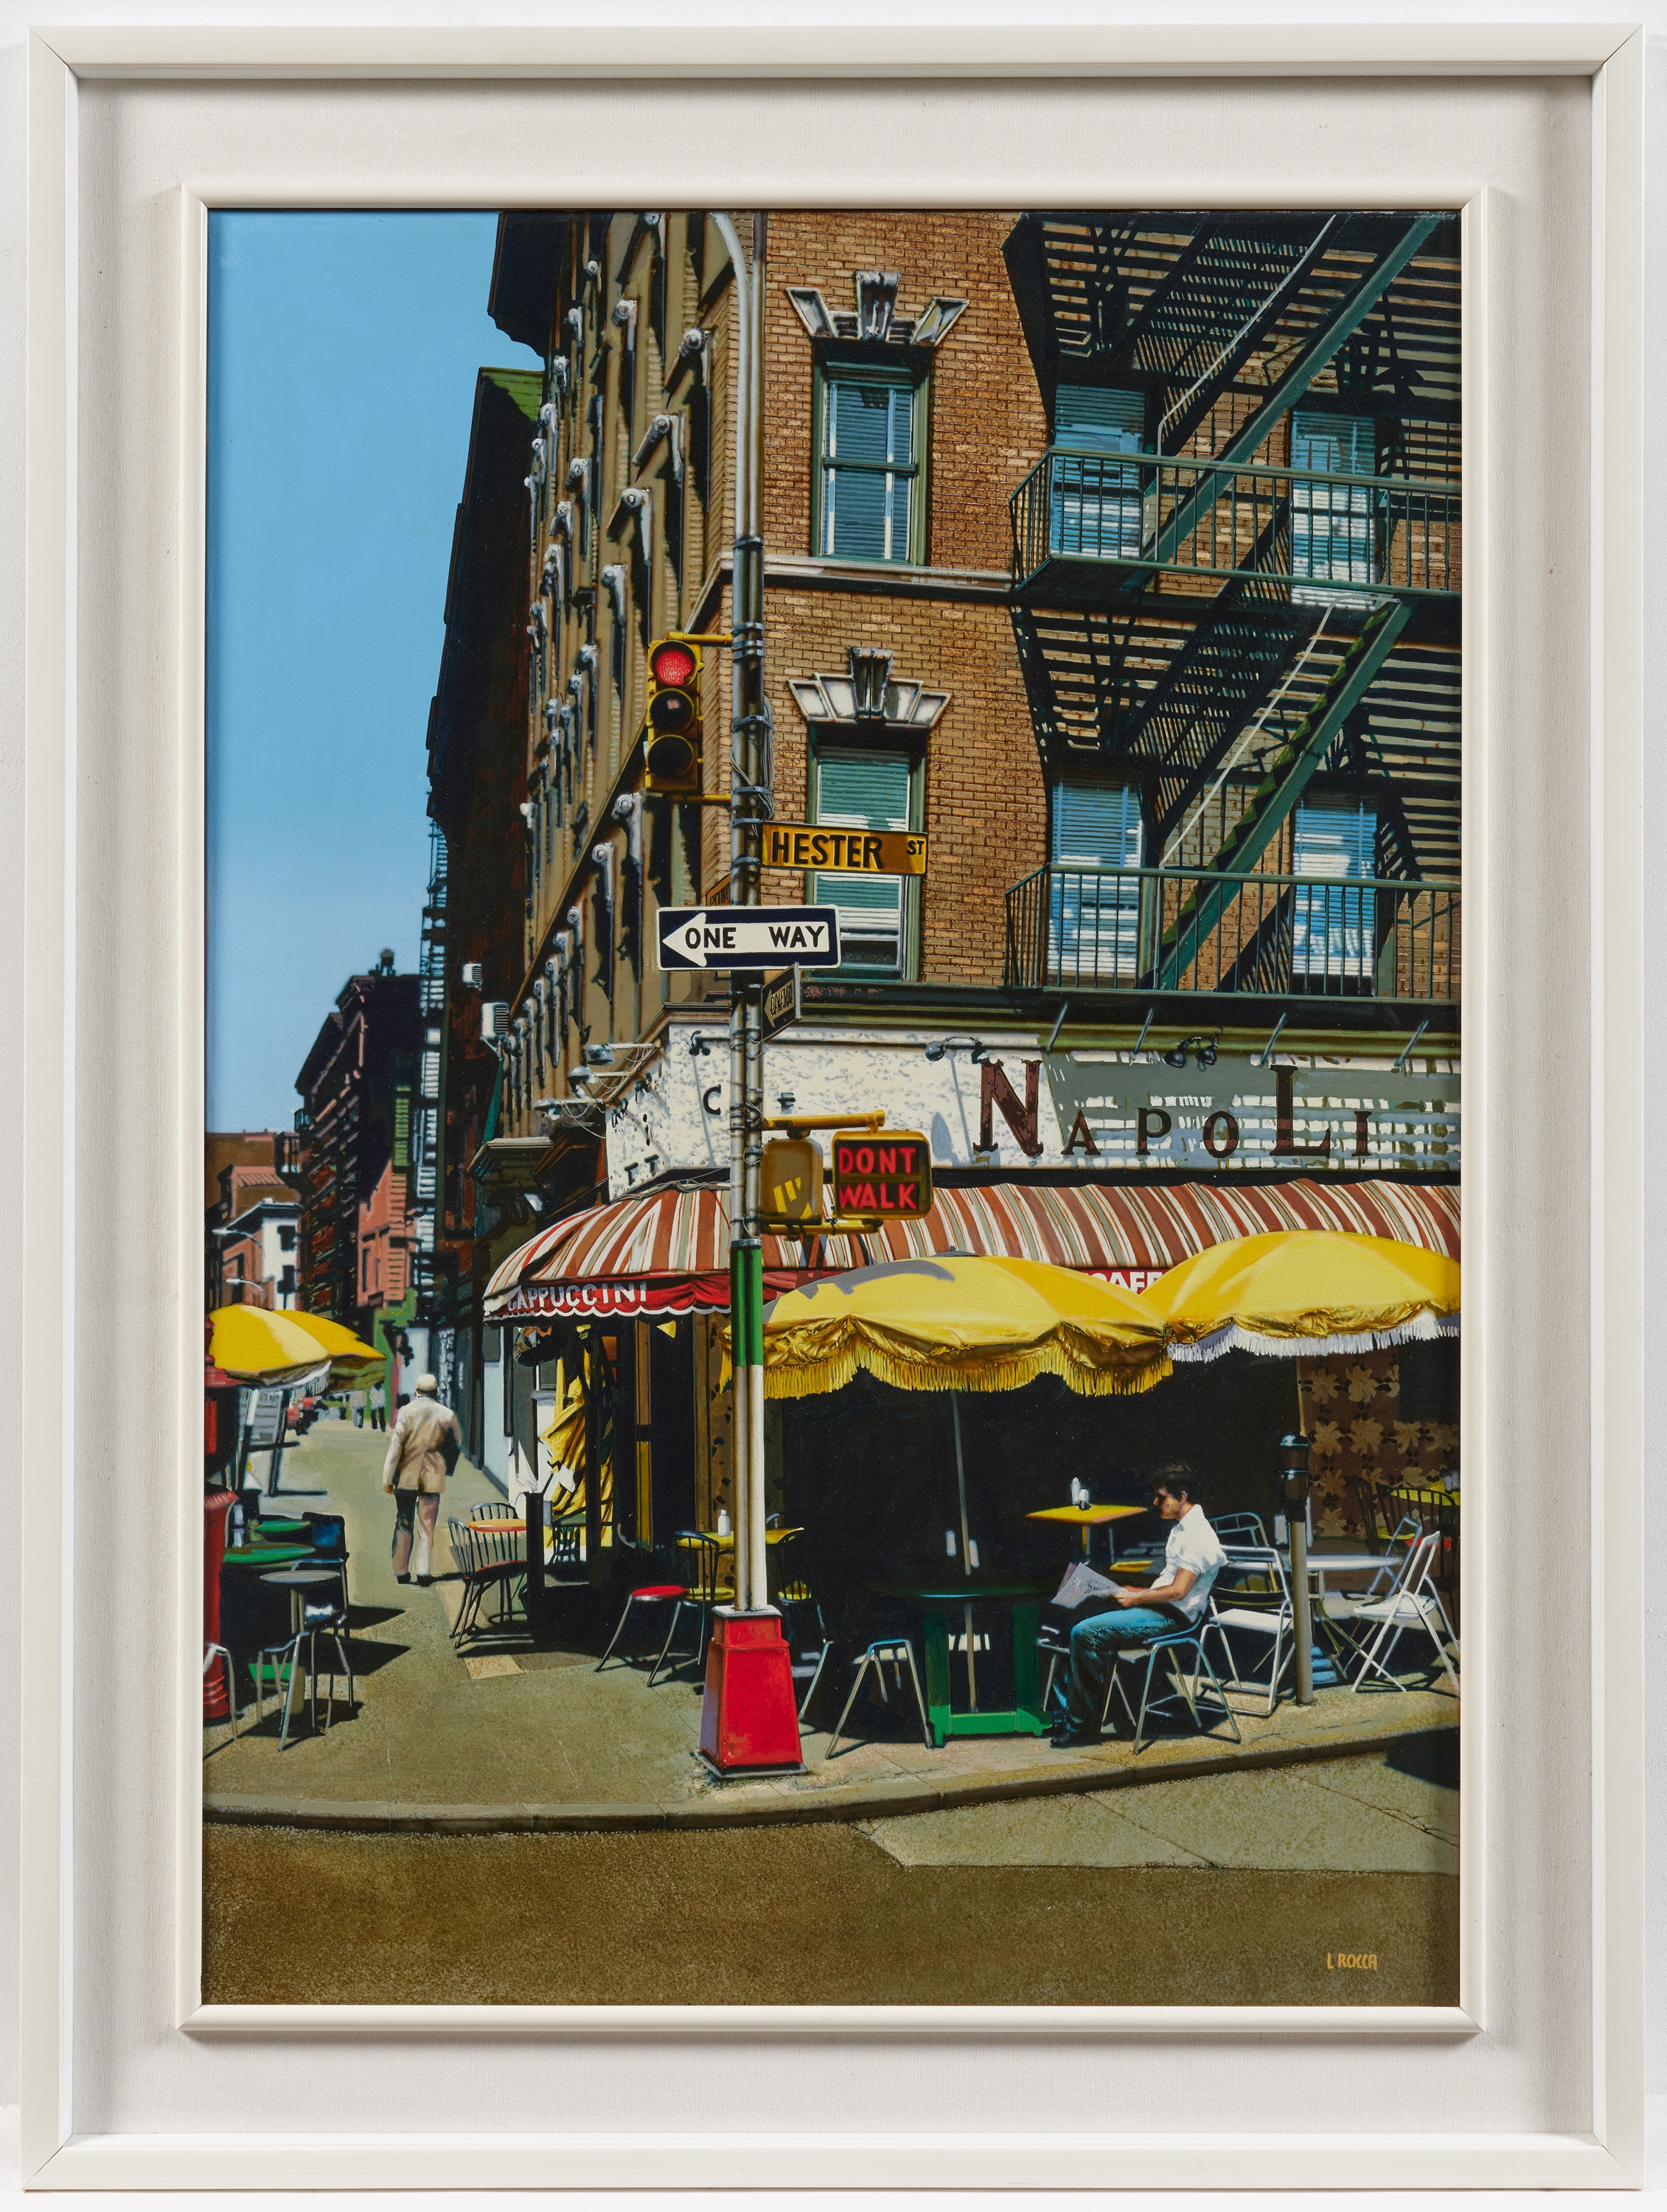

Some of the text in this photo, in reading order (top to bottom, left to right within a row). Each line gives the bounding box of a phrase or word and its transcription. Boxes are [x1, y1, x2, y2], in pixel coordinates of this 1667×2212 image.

[772, 831, 925, 869] HESTER ST
[685, 925, 825, 949] ONE WAY
[972, 1058, 1374, 1158] NAPOLI
[838, 1147, 916, 1175] DONT
[838, 1181, 917, 1211] WALK
[507, 1281, 647, 1312] CAPPUCCINI
[1327, 1952, 1377, 1971] L ROCCA
